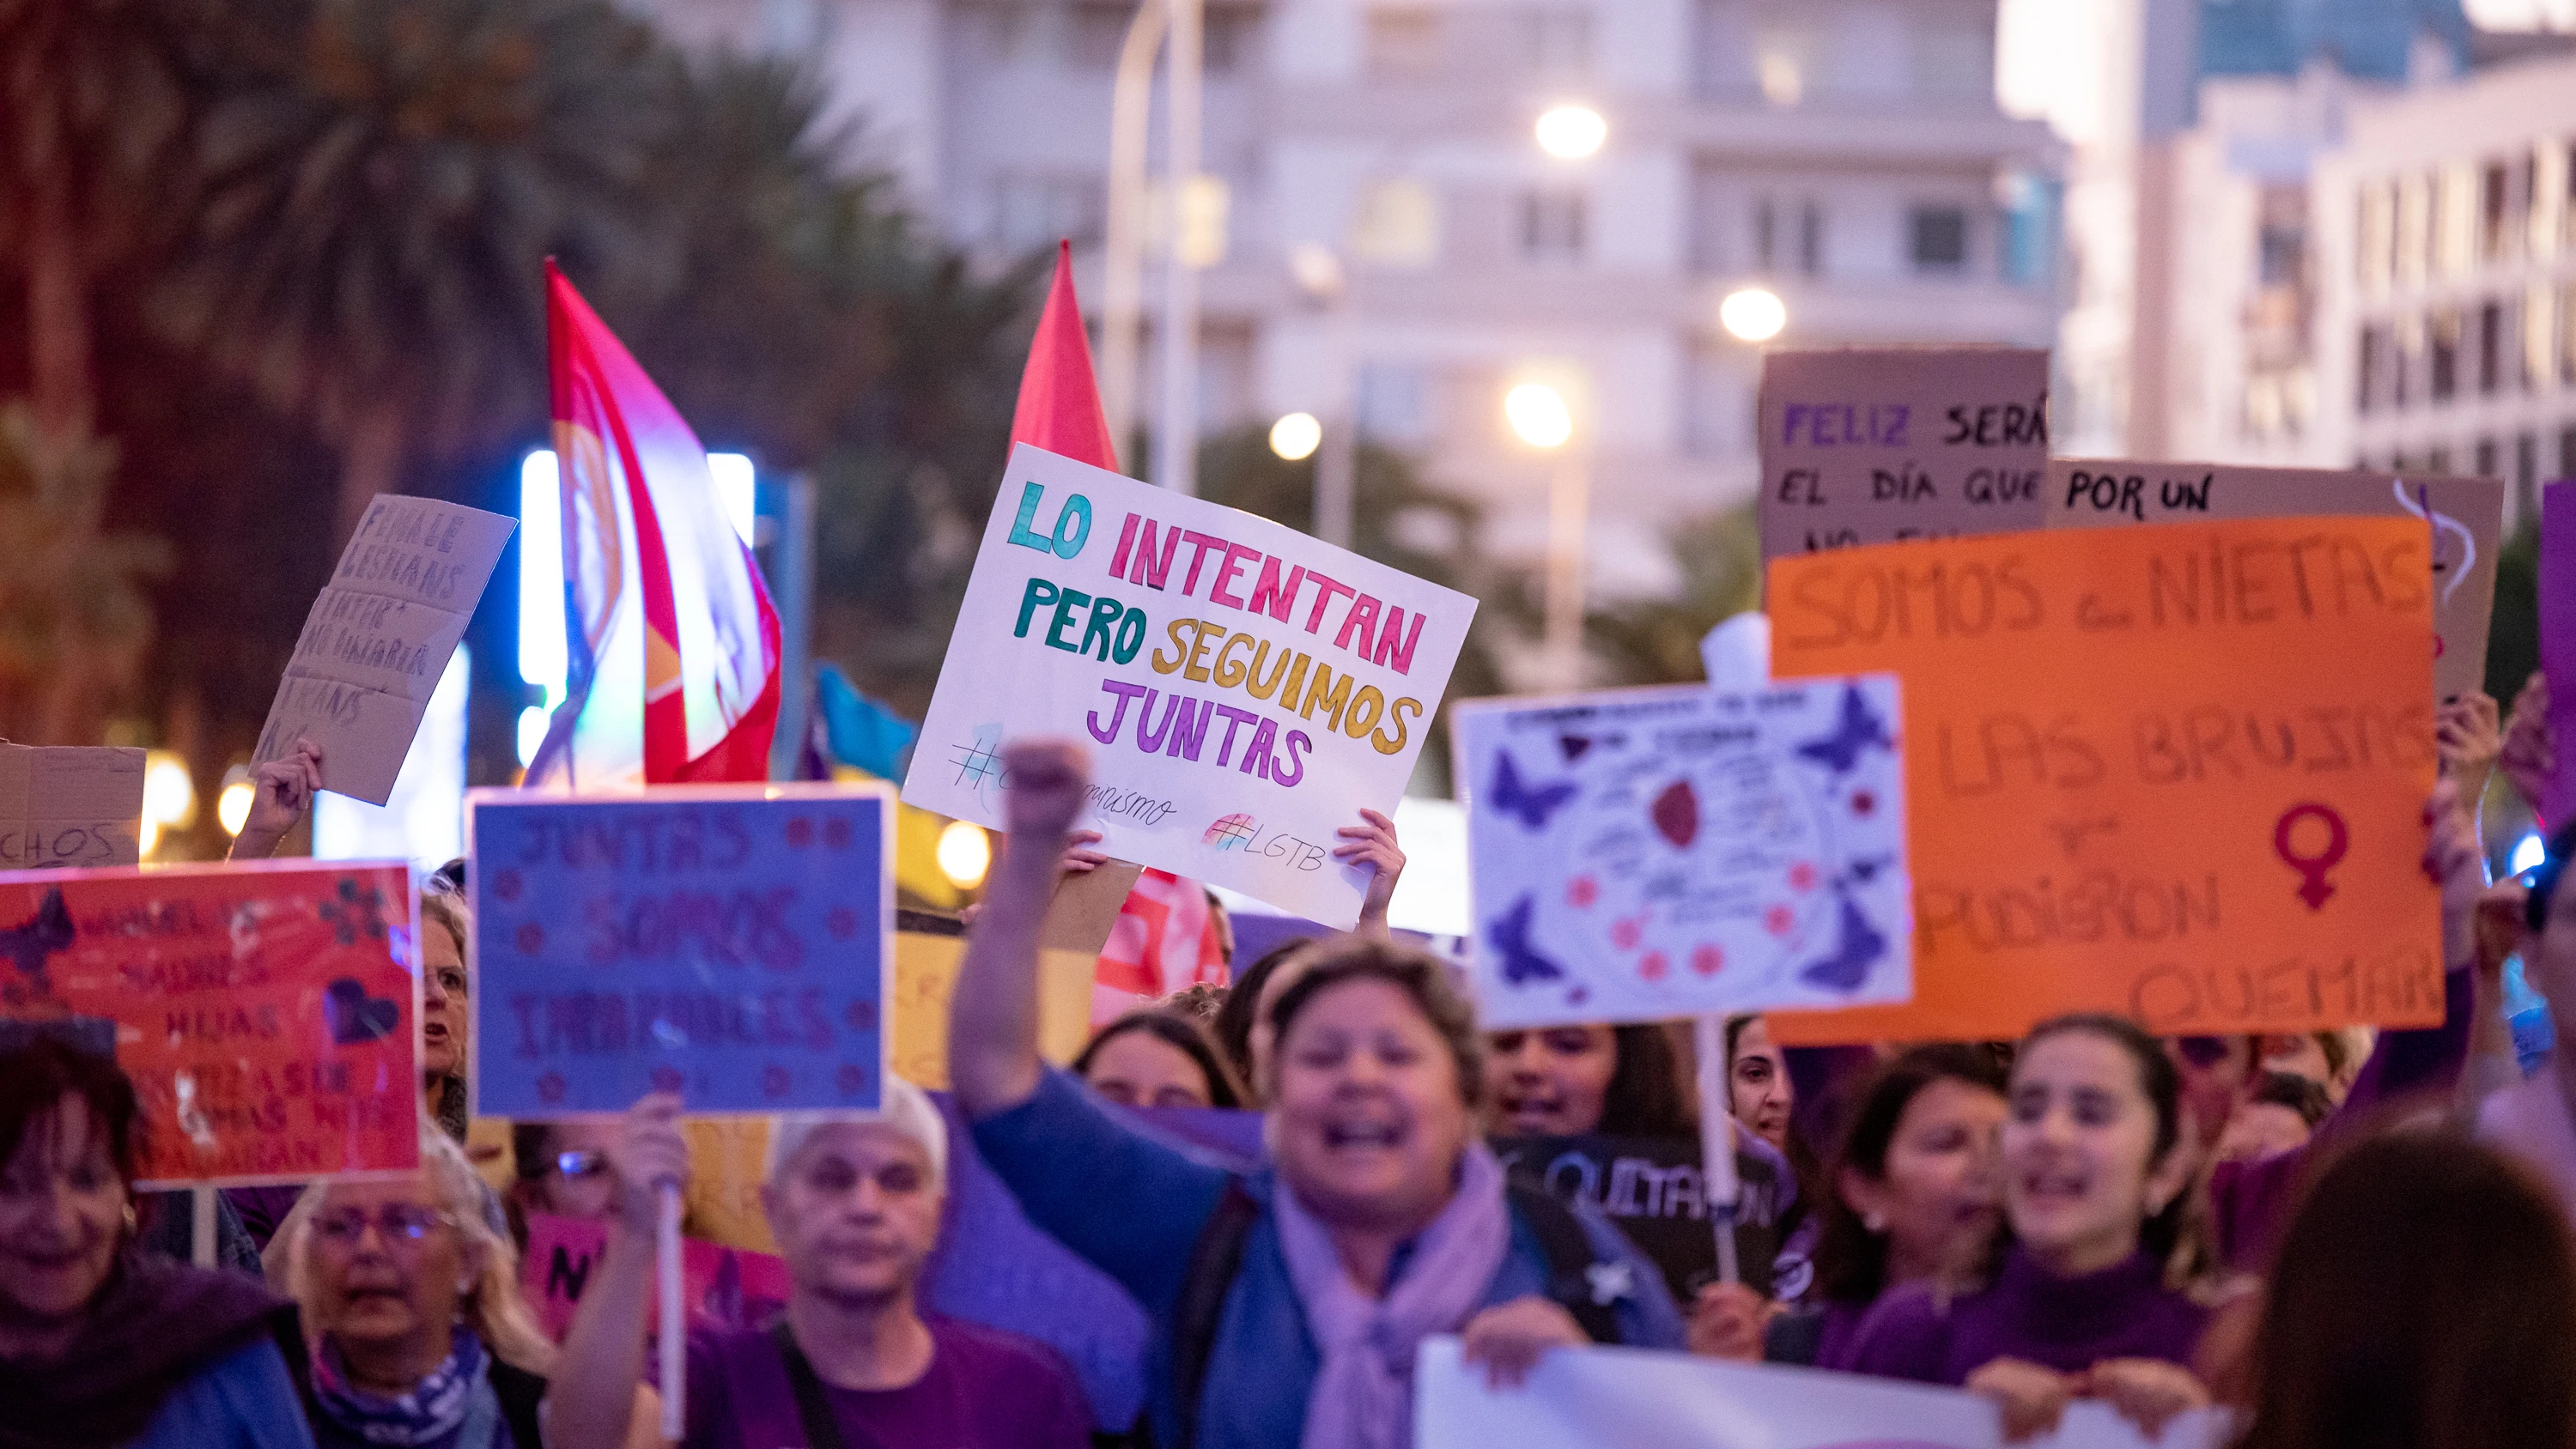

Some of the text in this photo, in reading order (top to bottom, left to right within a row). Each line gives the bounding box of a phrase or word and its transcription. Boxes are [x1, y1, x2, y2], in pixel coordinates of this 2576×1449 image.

[1783, 390, 2047, 447] FELIZ SERÁ
[1777, 458, 2040, 506] EL DÍA QUE
[2066, 470, 2214, 521] POR UN
[1007, 482, 1426, 675] LO INTENTAN
[1788, 554, 2045, 651] SOMOS
[2148, 533, 2426, 627] NIETAS
[1013, 578, 1423, 755] PERO SEGUIMOS
[1087, 679, 1312, 787] JUNTAS
[1936, 709, 2106, 798] LAS
[1210, 812, 1325, 871] #LGTB
